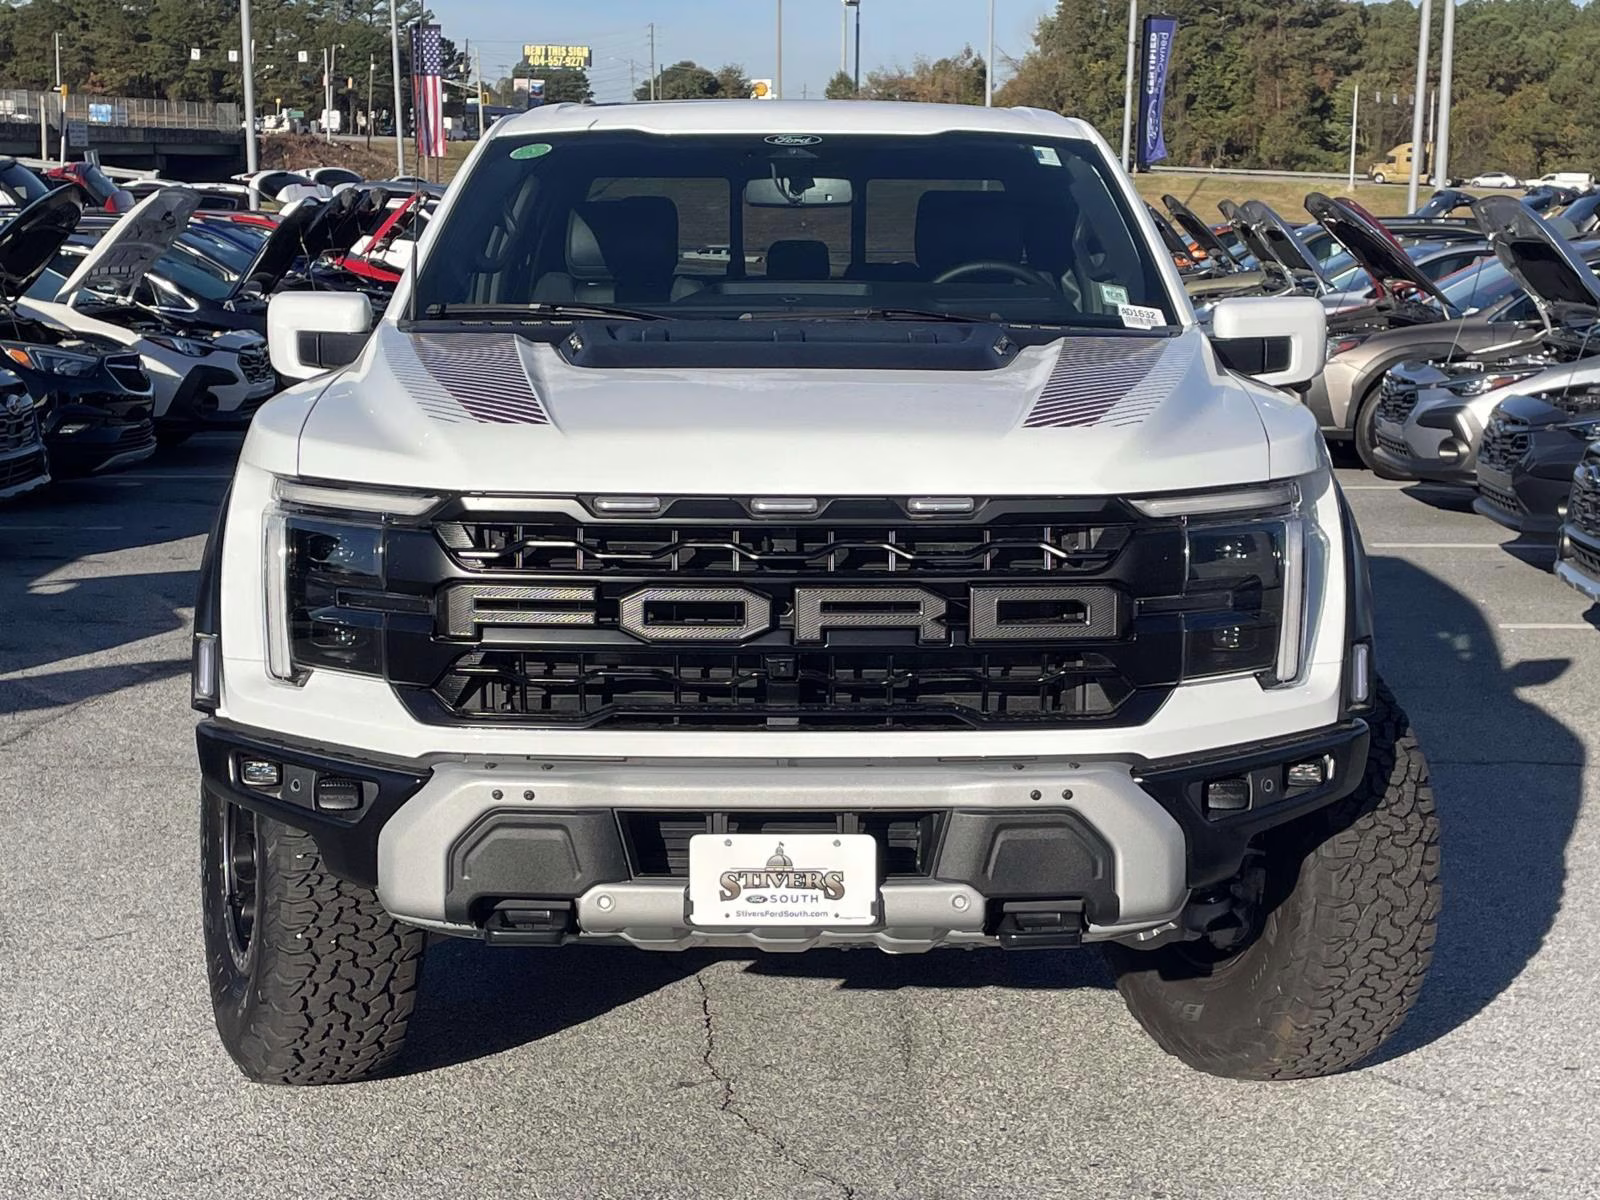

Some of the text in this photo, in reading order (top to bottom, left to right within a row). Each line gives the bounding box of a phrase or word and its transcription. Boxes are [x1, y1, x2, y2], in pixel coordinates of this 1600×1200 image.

[524, 45, 589, 57] RENT THIS SIGN
[528, 55, 584, 67] 404-557-9271
[1146, 32, 1157, 95] CERTIFIED
[774, 135, 812, 144] Ford
[1121, 307, 1156, 319] AD1632
[447, 583, 1119, 642] FORD
[719, 870, 845, 902] STIVERS
[770, 894, 818, 903] SOUTH
[735, 910, 828, 918] StiversFordSouth.com
